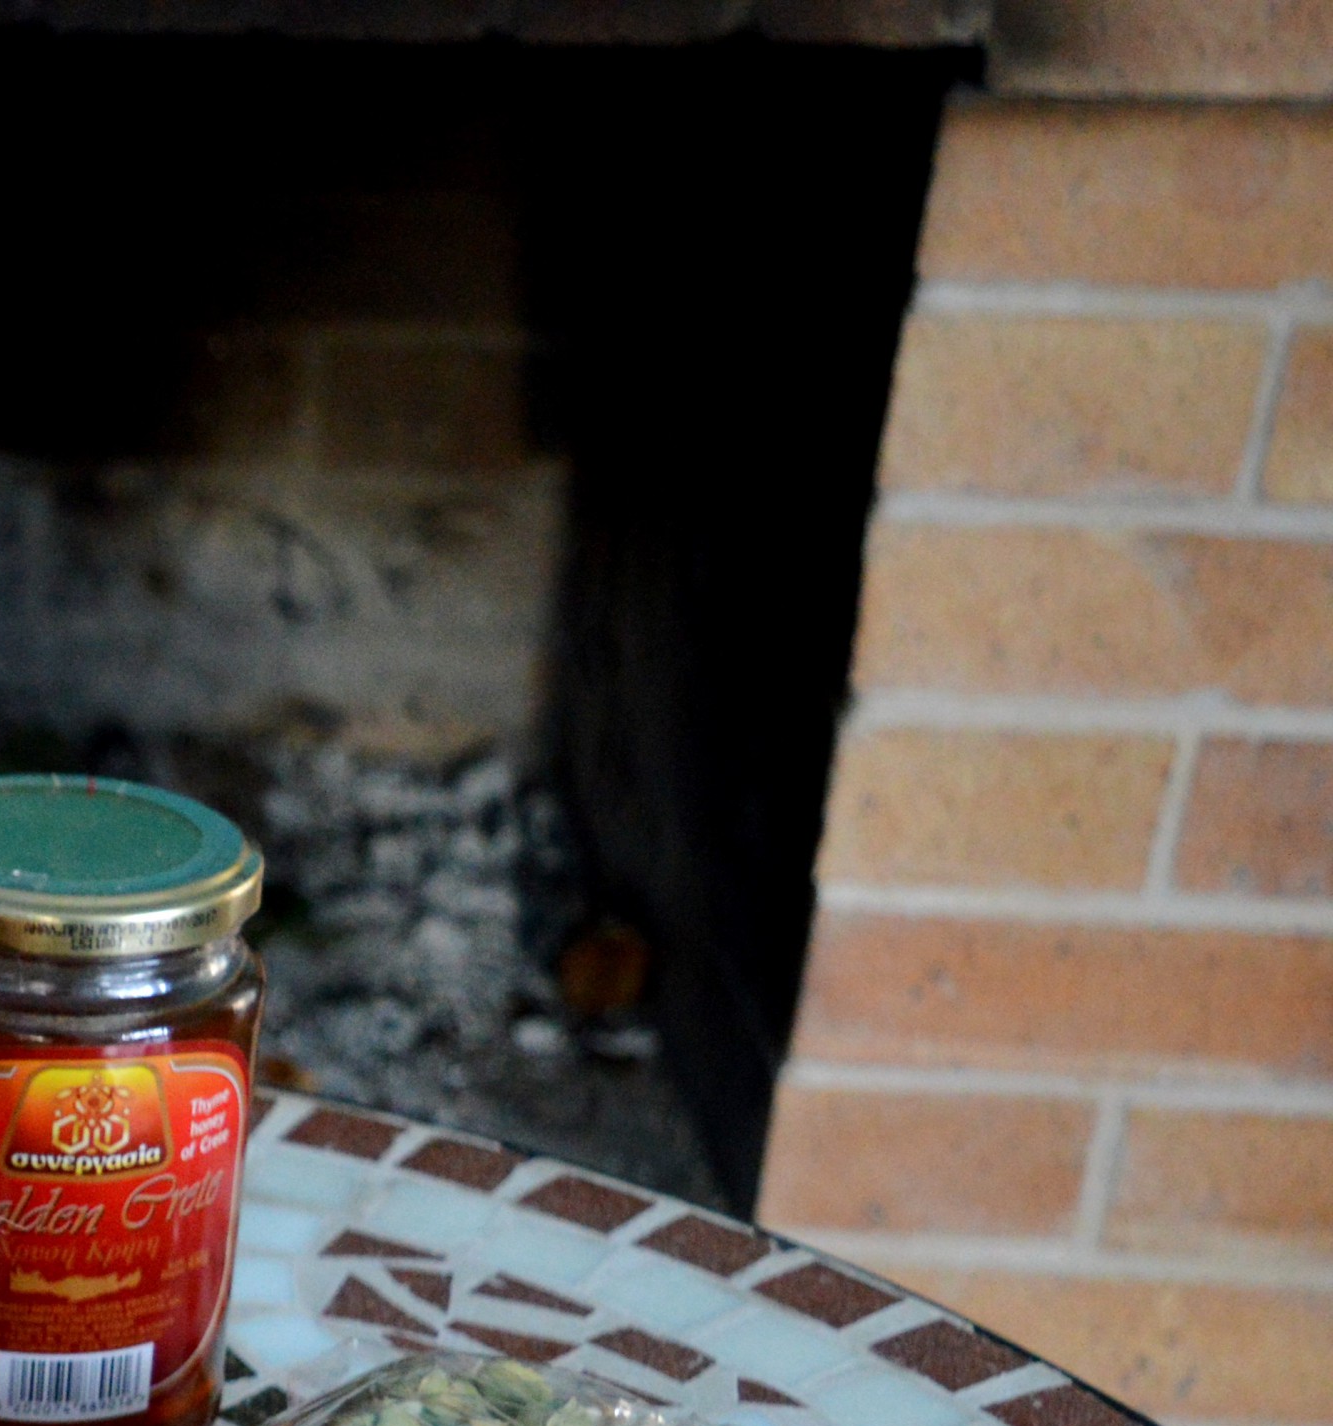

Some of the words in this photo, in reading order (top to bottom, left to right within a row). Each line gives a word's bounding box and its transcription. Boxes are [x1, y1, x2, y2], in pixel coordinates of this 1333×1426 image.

[191, 1089, 230, 1115] Thyme
[190, 1111, 228, 1138] honey
[180, 1142, 196, 1161] of
[199, 1129, 230, 1152] Crete
